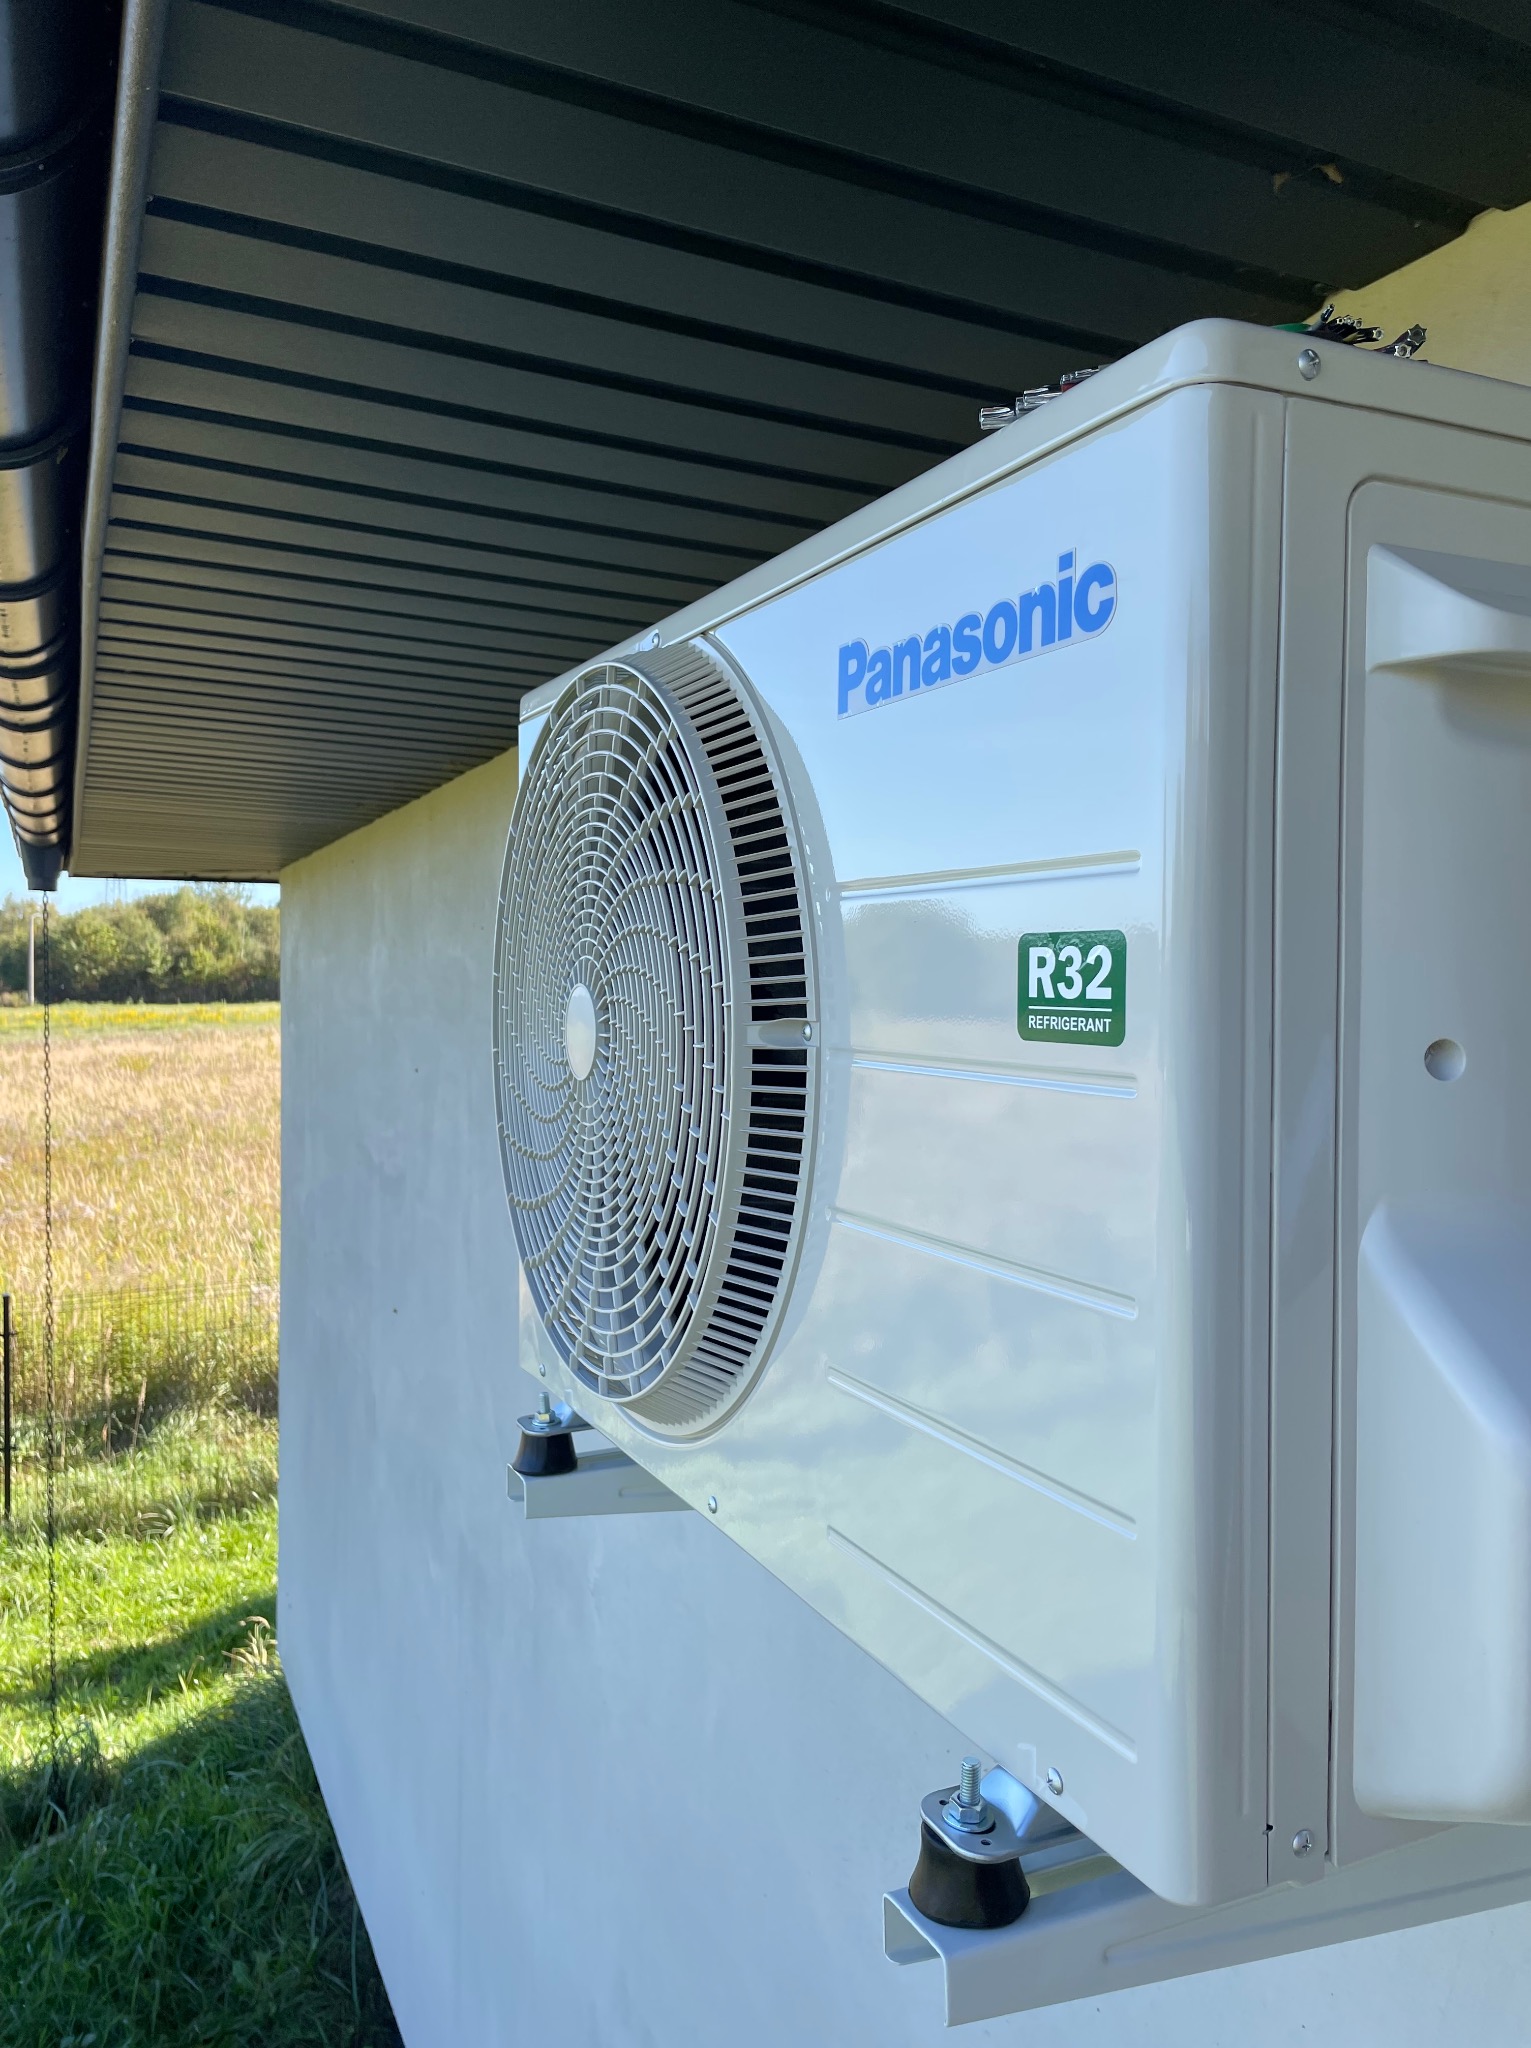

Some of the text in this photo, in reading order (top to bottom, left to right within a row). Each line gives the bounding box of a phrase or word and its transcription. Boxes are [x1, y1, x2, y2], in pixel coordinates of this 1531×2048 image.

[838, 551, 1115, 715] Panasonic
[1028, 944, 1112, 1000] R32
[1028, 1015, 1112, 1033] REFRIGERANT
